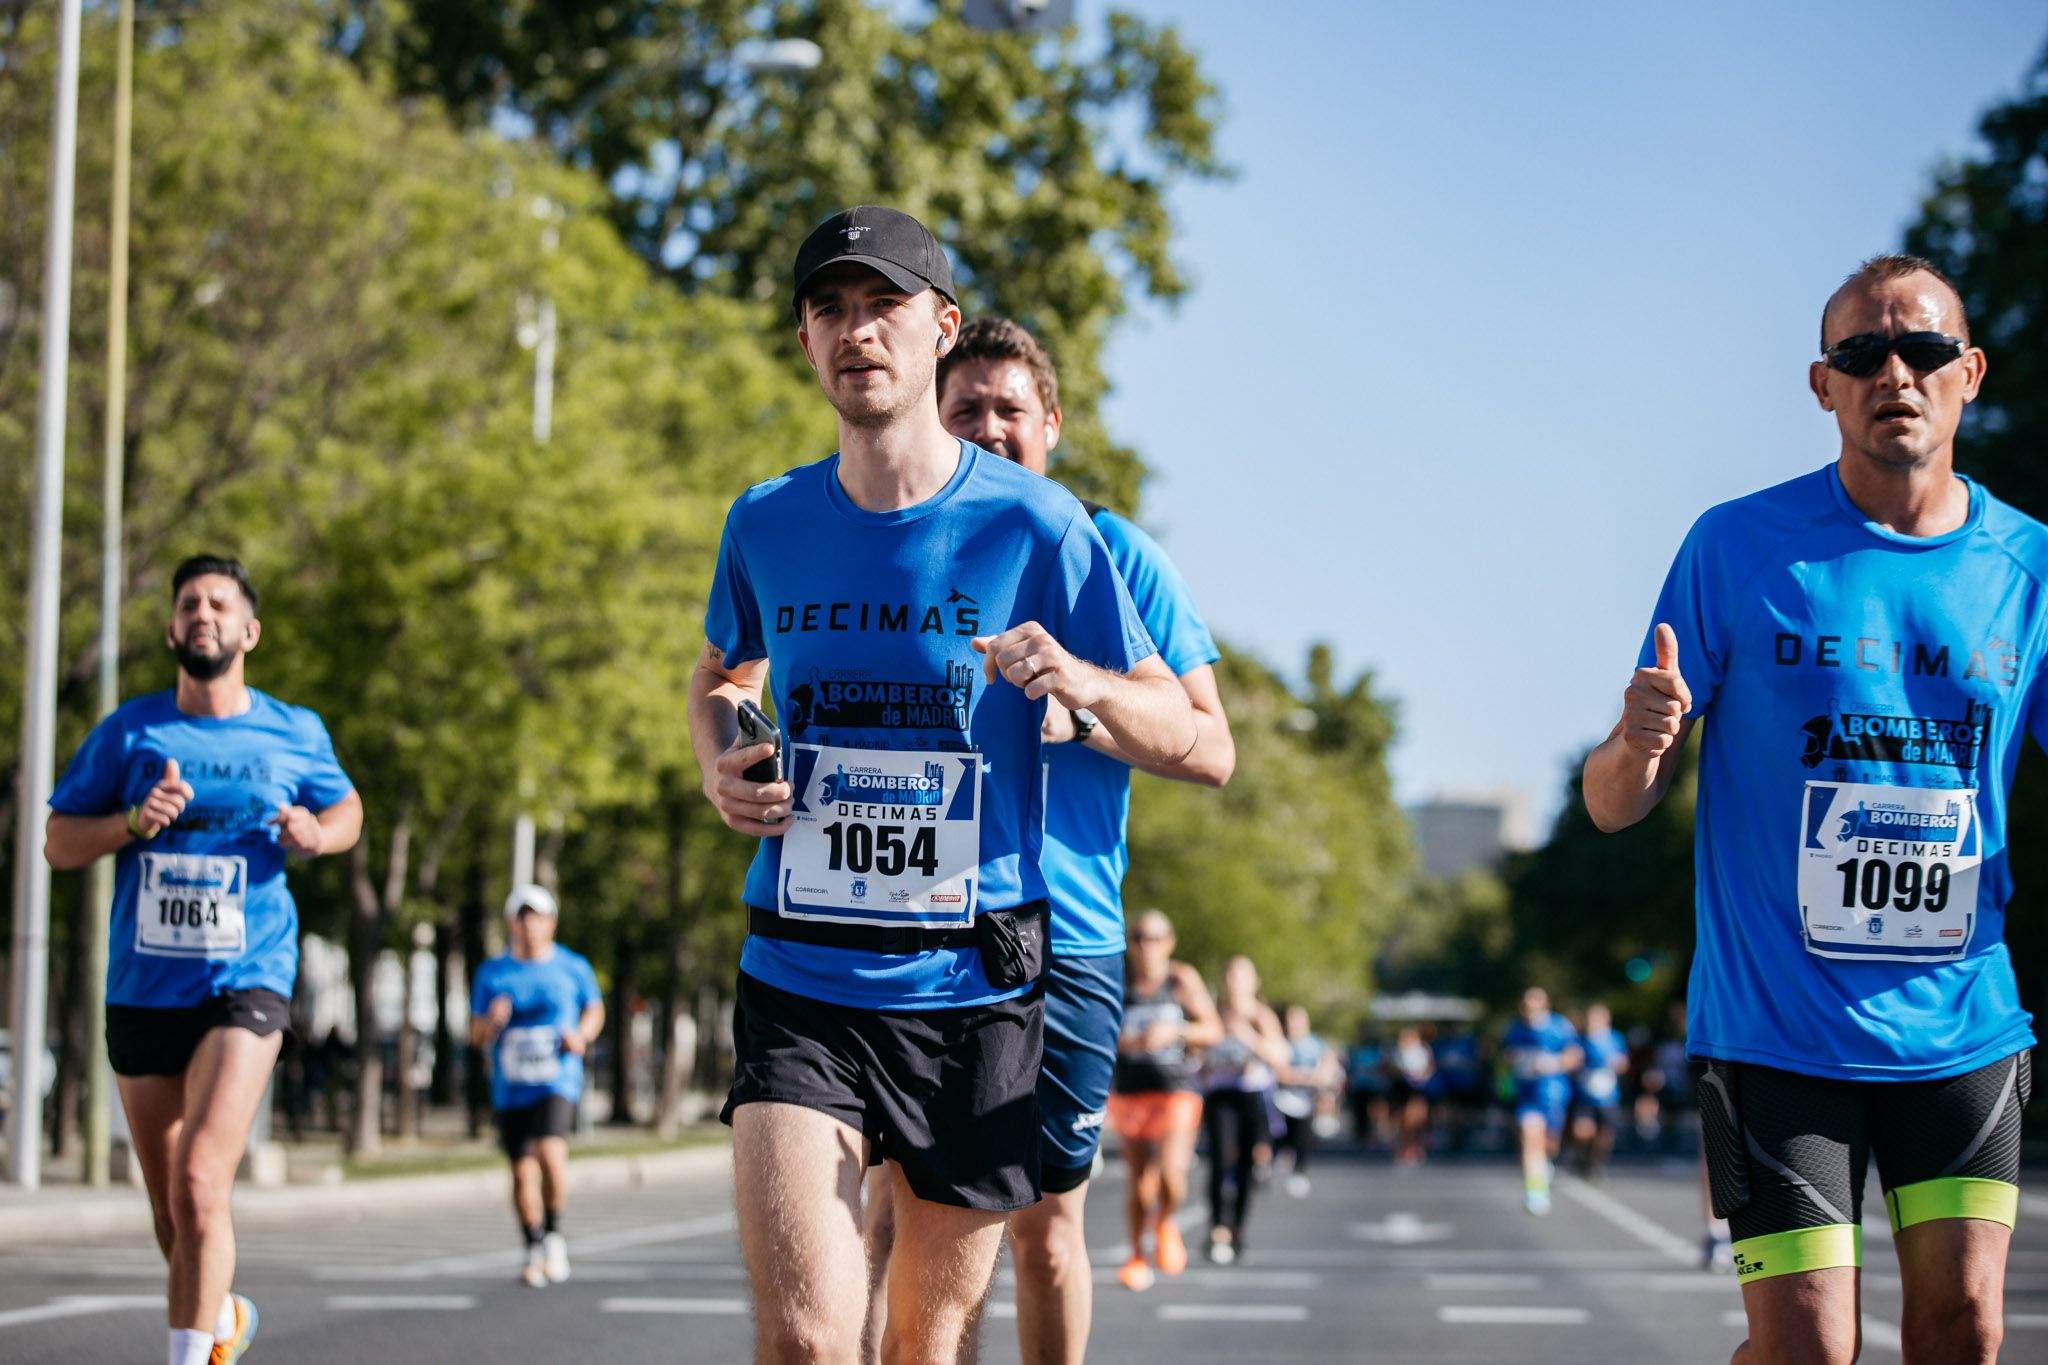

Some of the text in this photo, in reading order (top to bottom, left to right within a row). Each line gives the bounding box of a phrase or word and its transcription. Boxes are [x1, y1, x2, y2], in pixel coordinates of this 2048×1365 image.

[776, 602, 980, 636] DECIMAS
[1775, 632, 2020, 687] DECIMAS
[828, 683, 967, 707] BOMBEROS
[881, 706, 967, 730] de MADRID
[1849, 716, 1983, 744] BOMBEROS
[1901, 740, 1920, 761] de
[849, 766, 883, 775] CARRERA
[849, 775, 940, 791] BOMBEROS
[882, 790, 940, 804] de MADRID
[838, 803, 937, 821] DECIMAS
[1870, 811, 1957, 828] BOMBEROS
[823, 821, 939, 877] 1054
[1857, 839, 1952, 857] DECIMAS
[1836, 858, 1950, 913] 1099
[160, 898, 218, 928] 1064
